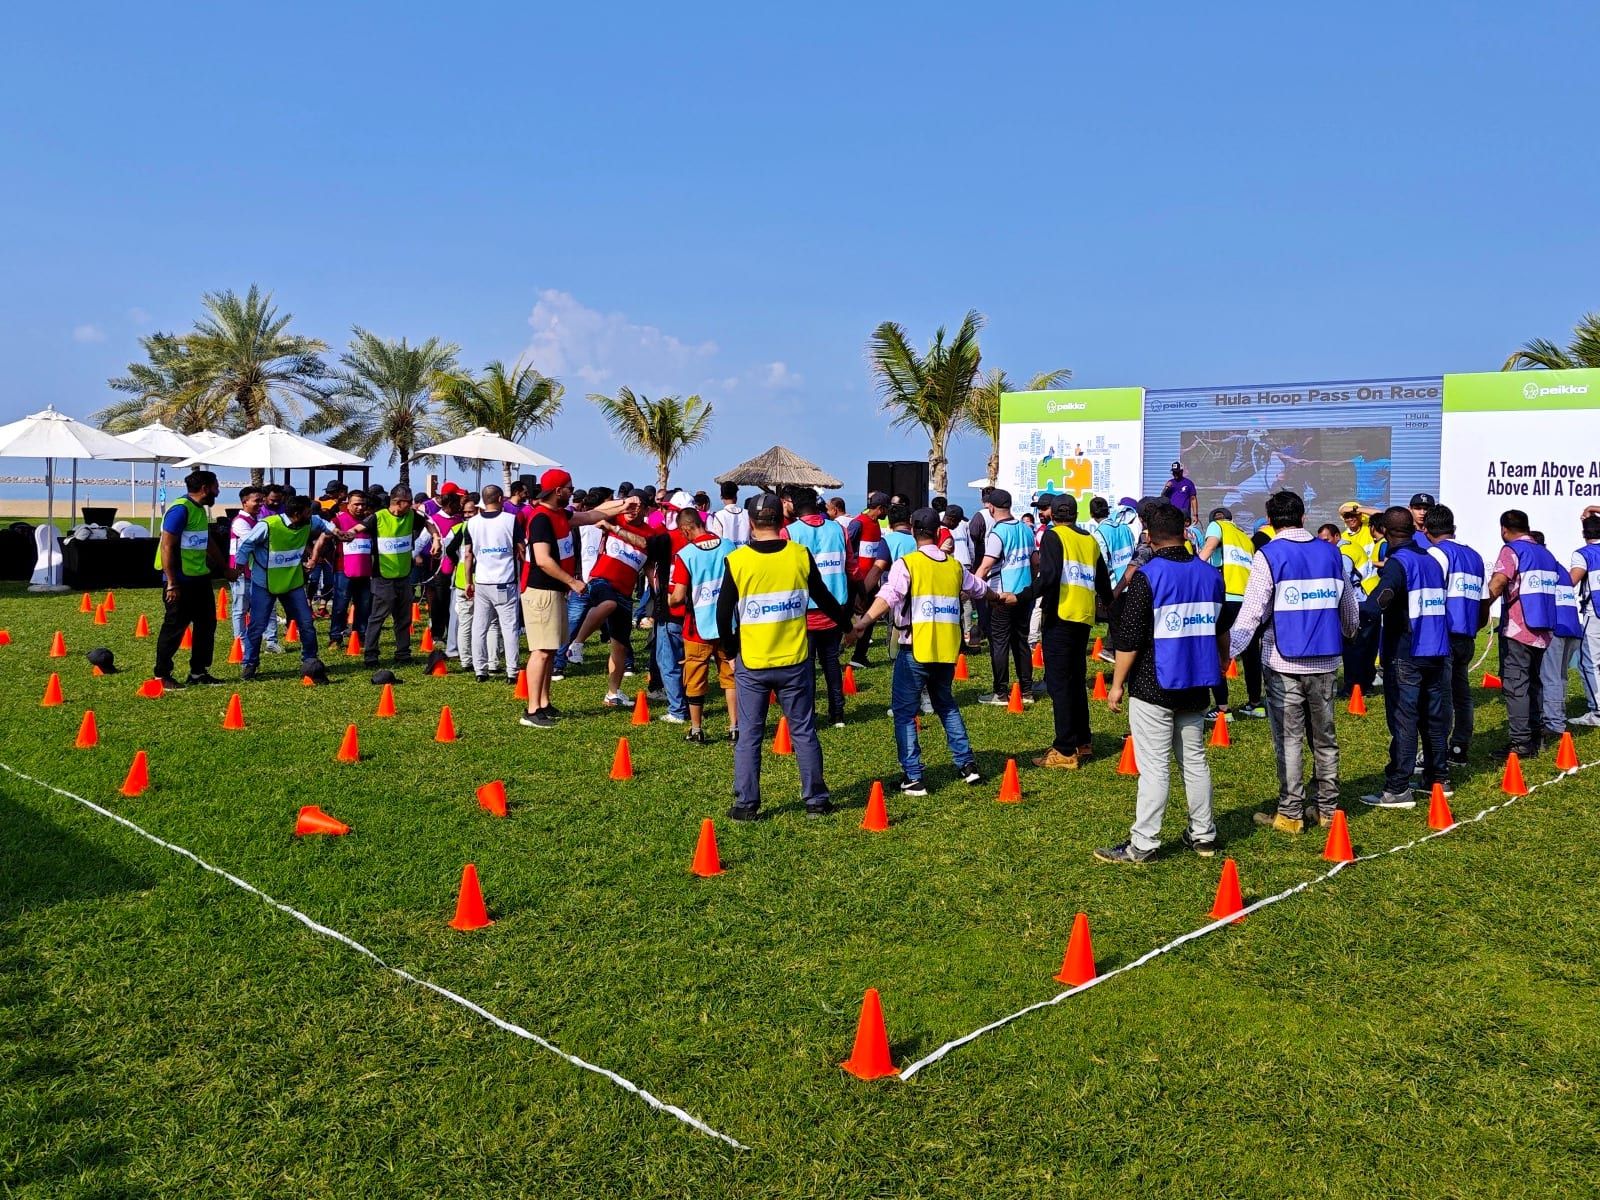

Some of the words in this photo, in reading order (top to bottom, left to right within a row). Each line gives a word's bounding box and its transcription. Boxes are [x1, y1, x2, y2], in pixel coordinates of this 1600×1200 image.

[1215, 393, 1251, 406] Hula
[1257, 391, 1301, 405] Hoop
[1308, 389, 1351, 402] Pass
[1357, 387, 1383, 400] On
[1390, 386, 1439, 399] Race
[1540, 385, 1588, 396] peikko
[1056, 402, 1086, 411] peikko
[1162, 401, 1198, 411] peikko
[1405, 421, 1429, 429] Hoop
[1488, 461, 1496, 477] A
[1500, 461, 1537, 478] Team
[1541, 461, 1585, 478] Above
[1487, 479, 1529, 496] Above
[1532, 479, 1550, 496] All
[1555, 480, 1564, 496] A
[762, 600, 801, 615] peikko
